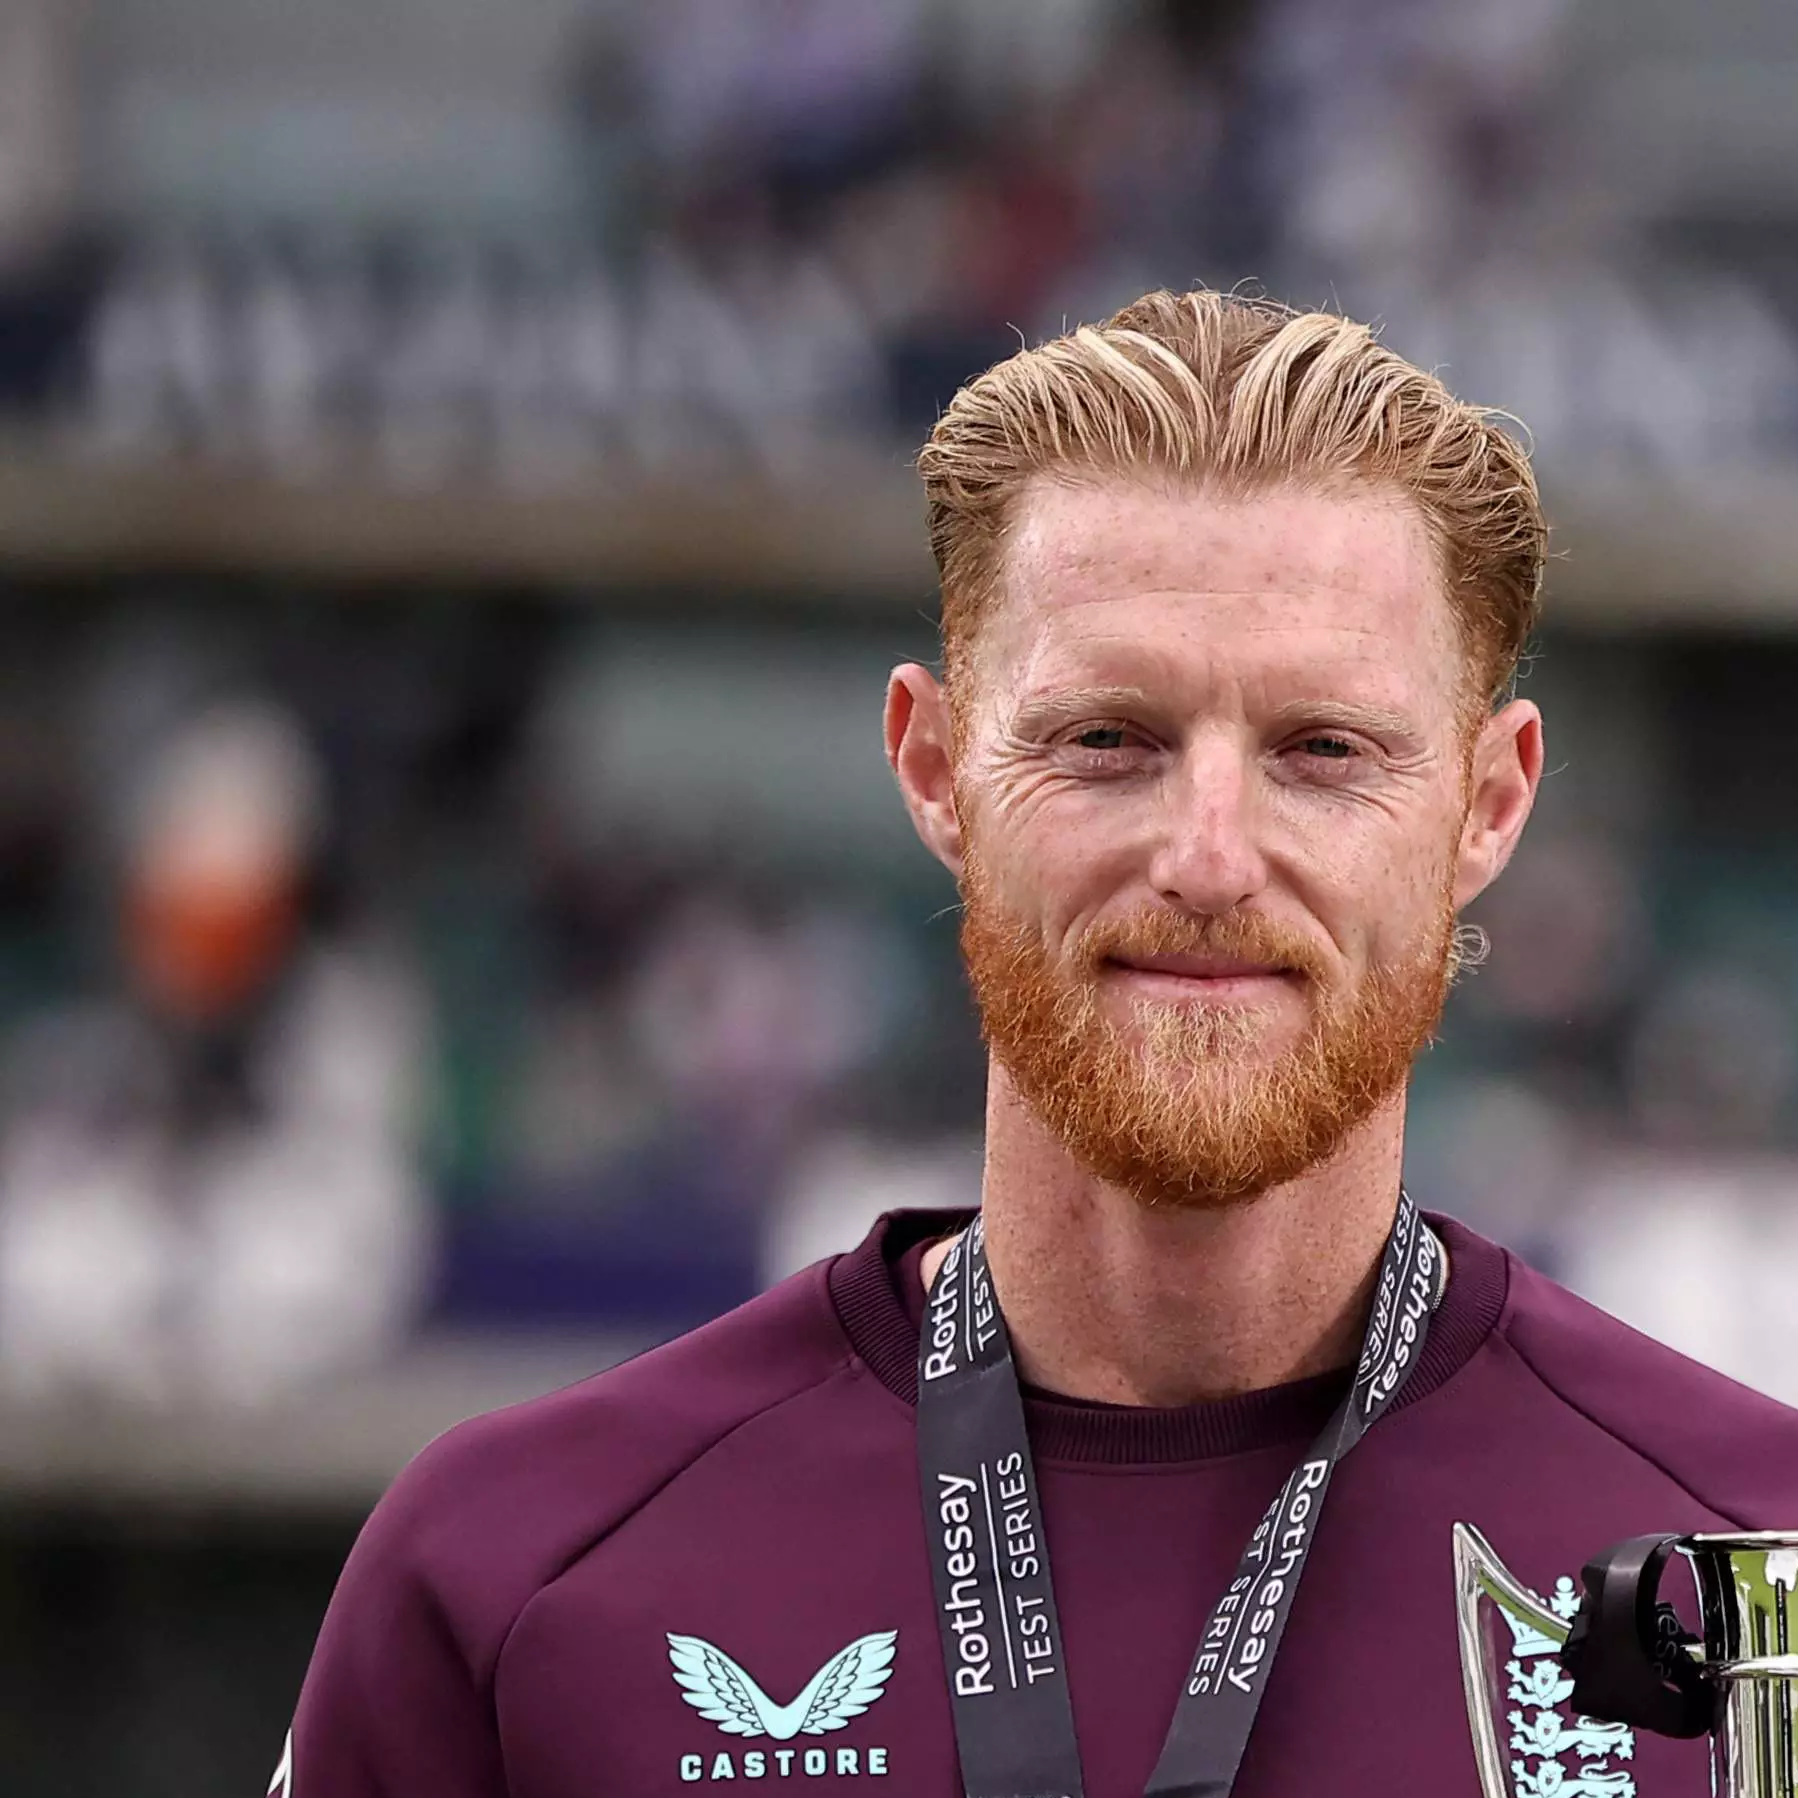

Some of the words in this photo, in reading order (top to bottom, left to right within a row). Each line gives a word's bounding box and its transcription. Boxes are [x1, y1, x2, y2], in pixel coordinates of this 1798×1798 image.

[924, 1246, 961, 1381] Rothe
[973, 1266, 997, 1352] TEST
[1358, 1264, 1396, 1375] SERIES
[1365, 1223, 1436, 1414] Rothesay
[996, 1451, 1039, 1579] SERIES
[1247, 1483, 1287, 1562] EST
[937, 1473, 994, 1696] Rothesay
[1188, 1575, 1251, 1696] SERIES
[1227, 1459, 1328, 1694] Rothesay
[1016, 1594, 1056, 1684] TEST
[680, 1747, 889, 1782] CASTORE
